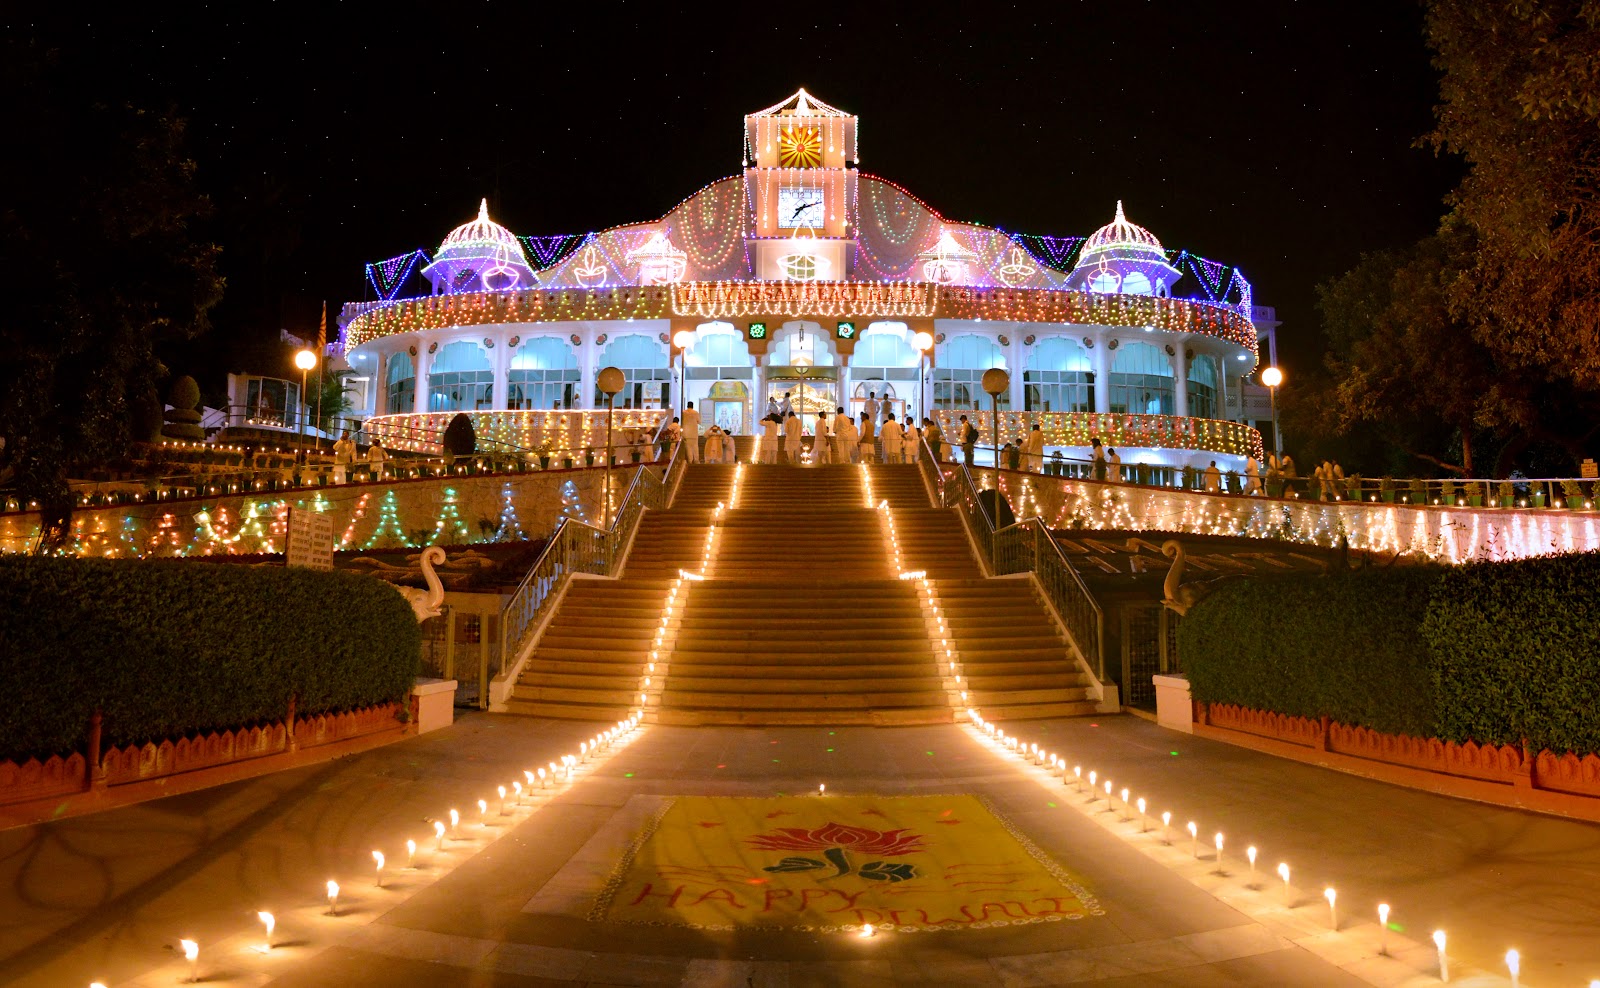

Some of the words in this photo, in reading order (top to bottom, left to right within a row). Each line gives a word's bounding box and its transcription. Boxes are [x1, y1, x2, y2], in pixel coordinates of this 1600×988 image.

[684, 286, 799, 301] UNIVERSAL
[804, 286, 862, 301] PEACE
[868, 286, 922, 301] HALL
[629, 883, 866, 913] HAPPY
[850, 896, 1082, 926] DIWALI
